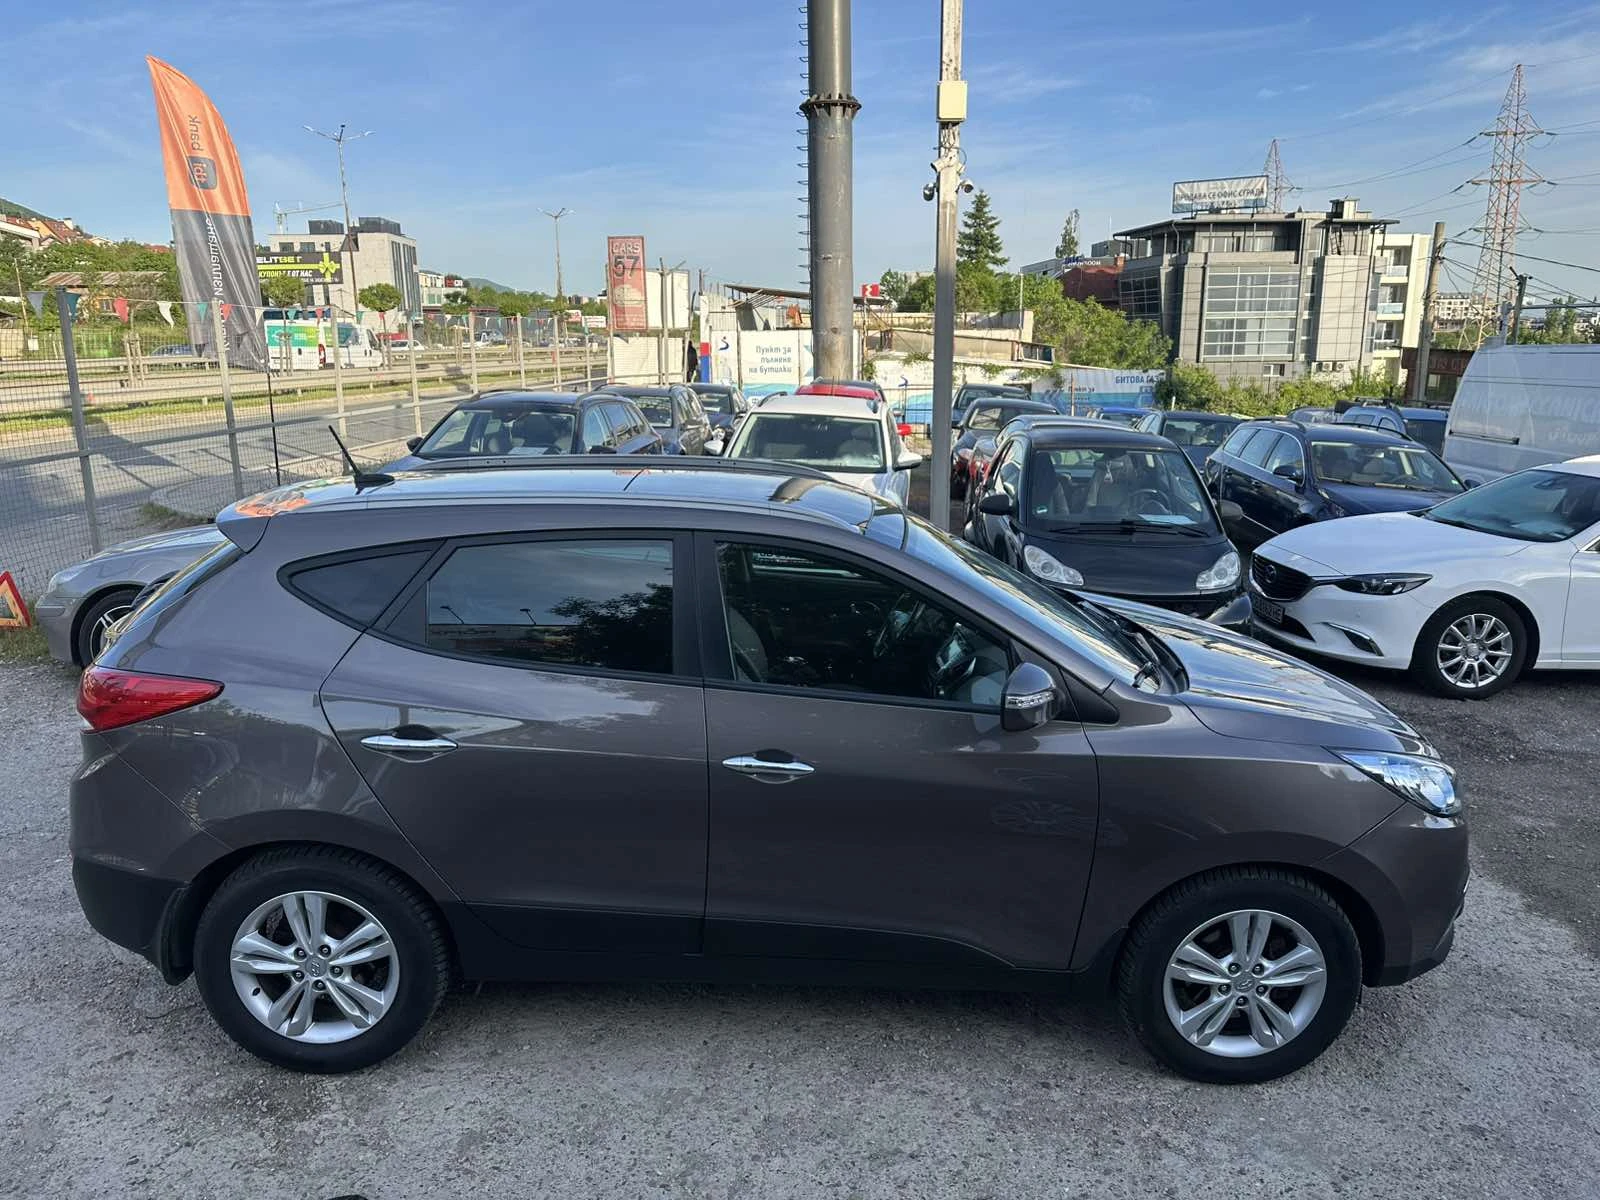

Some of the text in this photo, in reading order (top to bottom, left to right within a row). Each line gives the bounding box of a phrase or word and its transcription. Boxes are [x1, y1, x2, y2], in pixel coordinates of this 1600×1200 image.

[1175, 187, 1265, 202] ПРОДАВА СЕ ОФИС СГРАДА
[612, 242, 641, 255] CARS
[614, 255, 640, 278] 57
[755, 345, 792, 355] Пункт за
[759, 365, 792, 375] бутилки
[1115, 375, 1145, 385] БИТОВА
